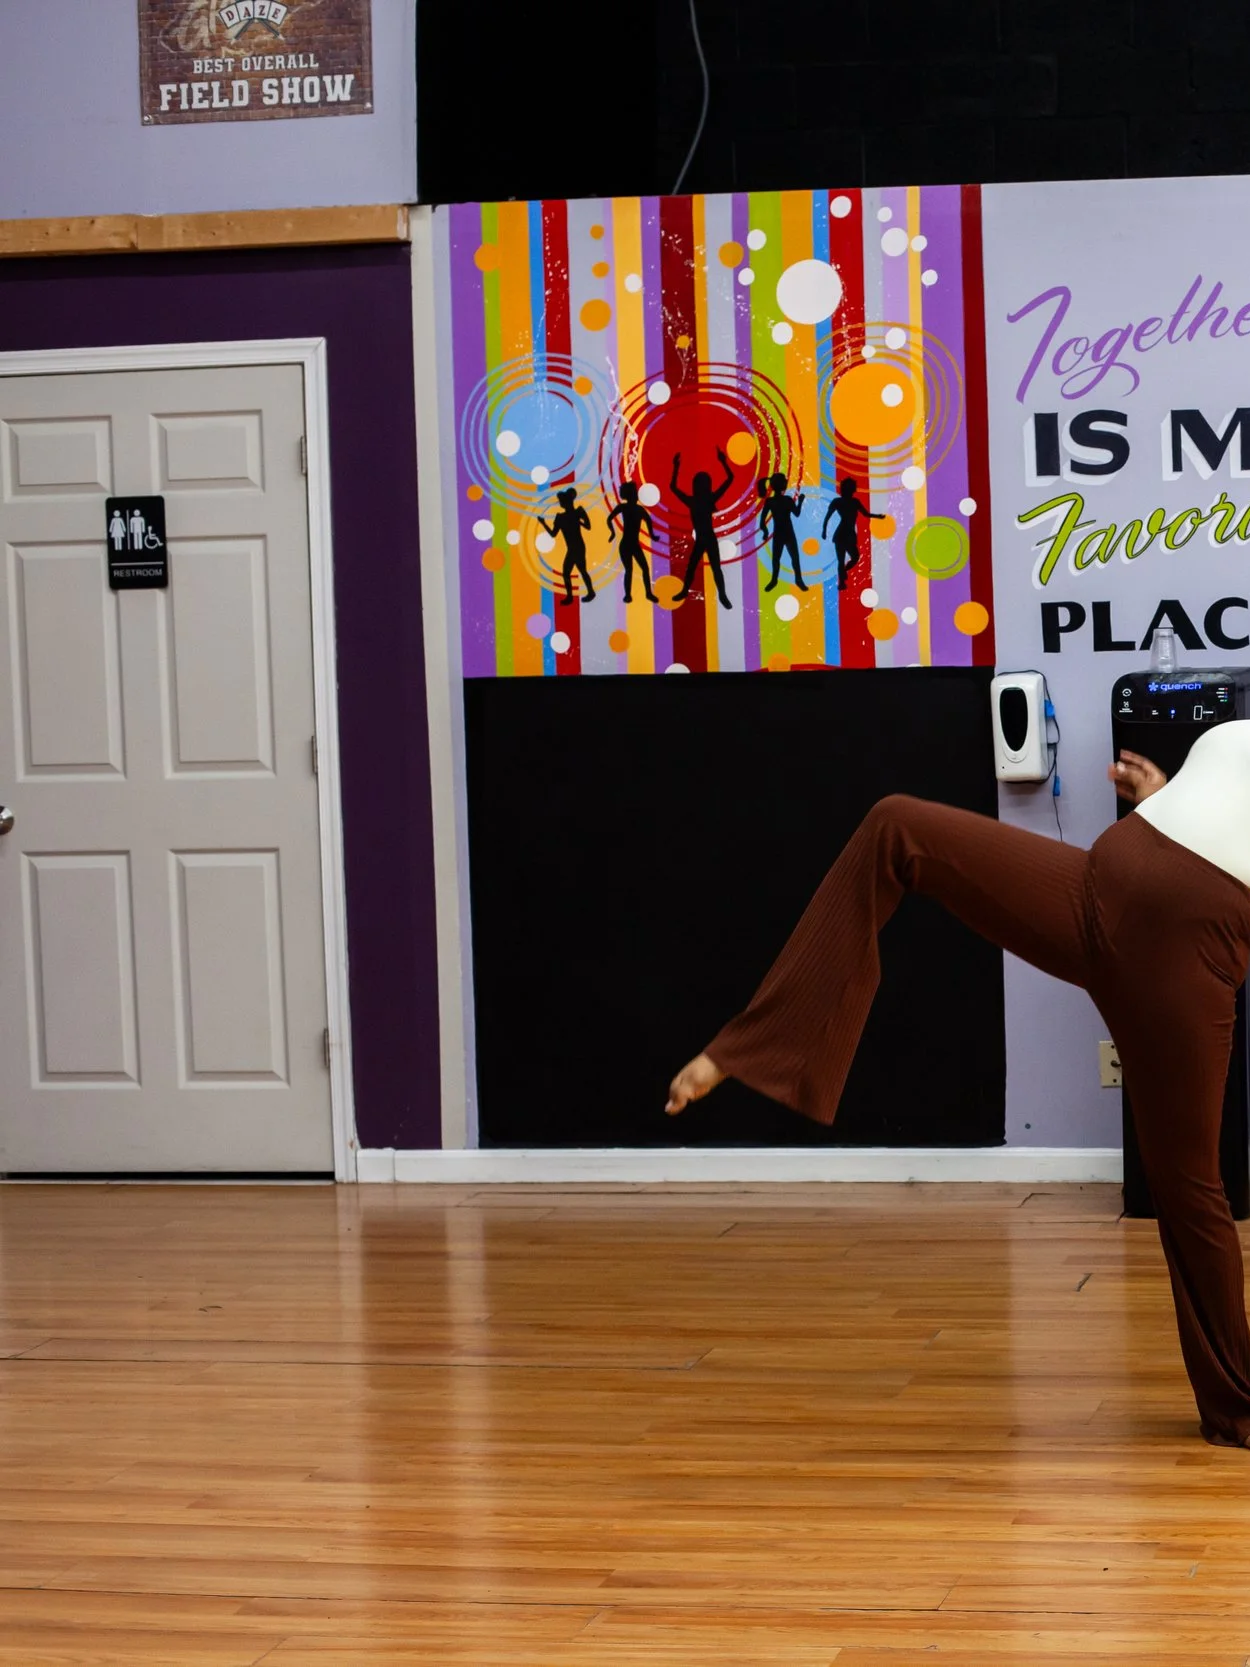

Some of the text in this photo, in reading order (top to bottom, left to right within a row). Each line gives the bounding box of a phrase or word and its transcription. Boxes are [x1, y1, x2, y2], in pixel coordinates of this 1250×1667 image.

[224, 3, 282, 23] DAZE
[193, 53, 319, 74] BEST OVERALL
[159, 74, 355, 111] FIELD SHOW
[1030, 409, 1131, 480] IS
[113, 568, 163, 577] RESTROOM
[1160, 681, 1202, 692] quench
